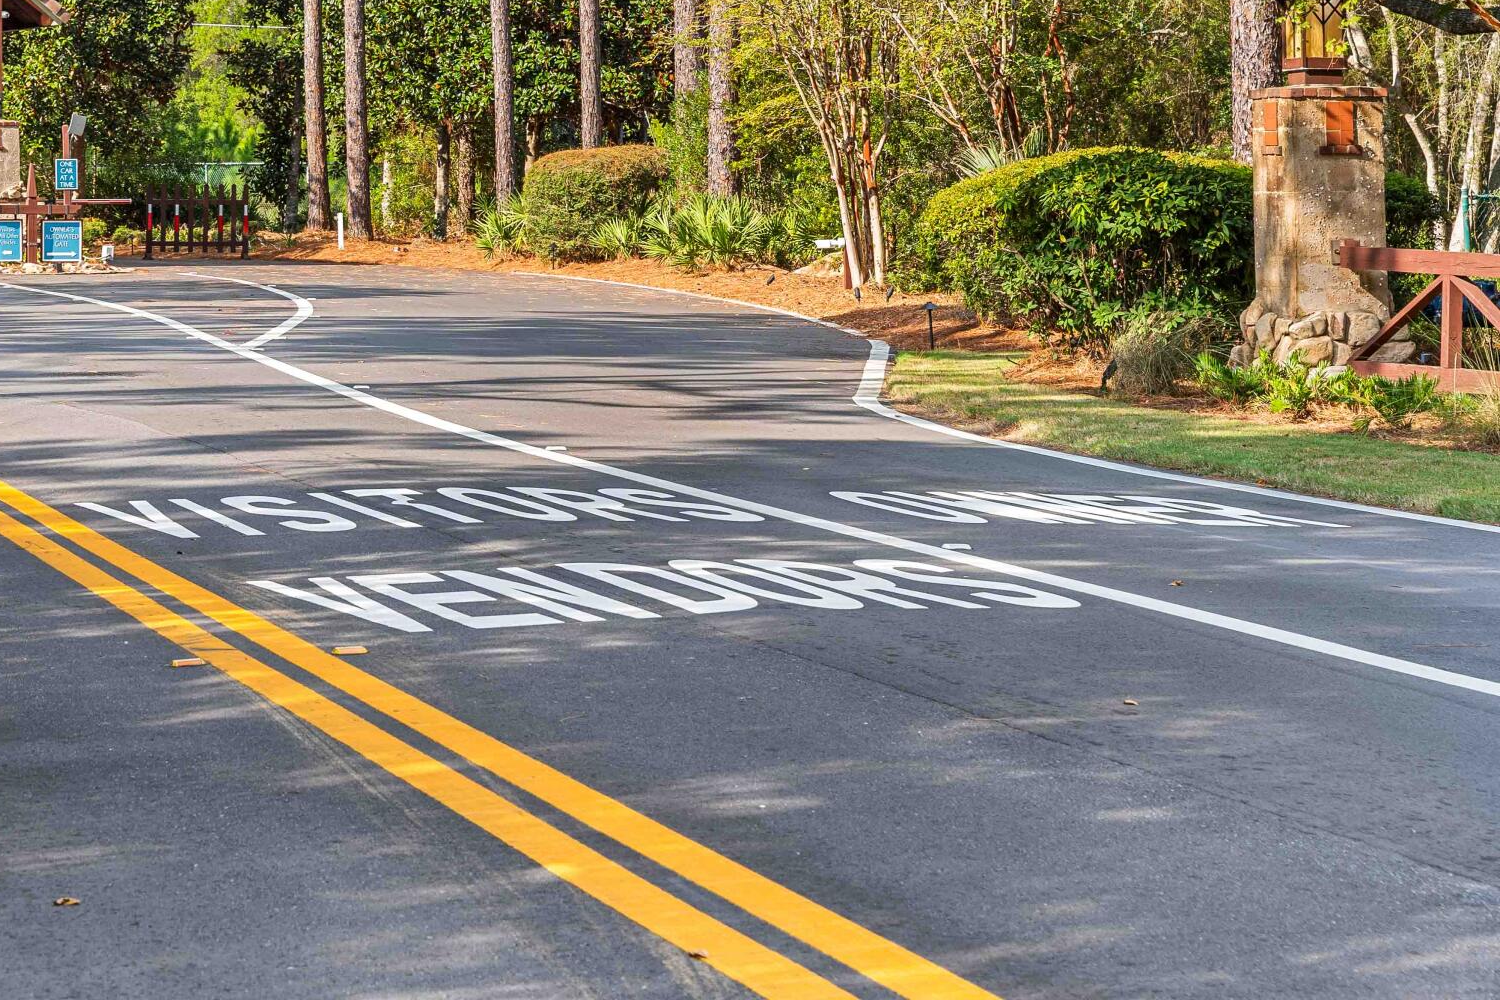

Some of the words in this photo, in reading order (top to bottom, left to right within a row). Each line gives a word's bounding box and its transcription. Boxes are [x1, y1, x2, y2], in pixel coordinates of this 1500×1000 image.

[75, 486, 766, 538] VISITORS
[829, 490, 1352, 528] OWNER
[245, 559, 1082, 633] VENDORS
